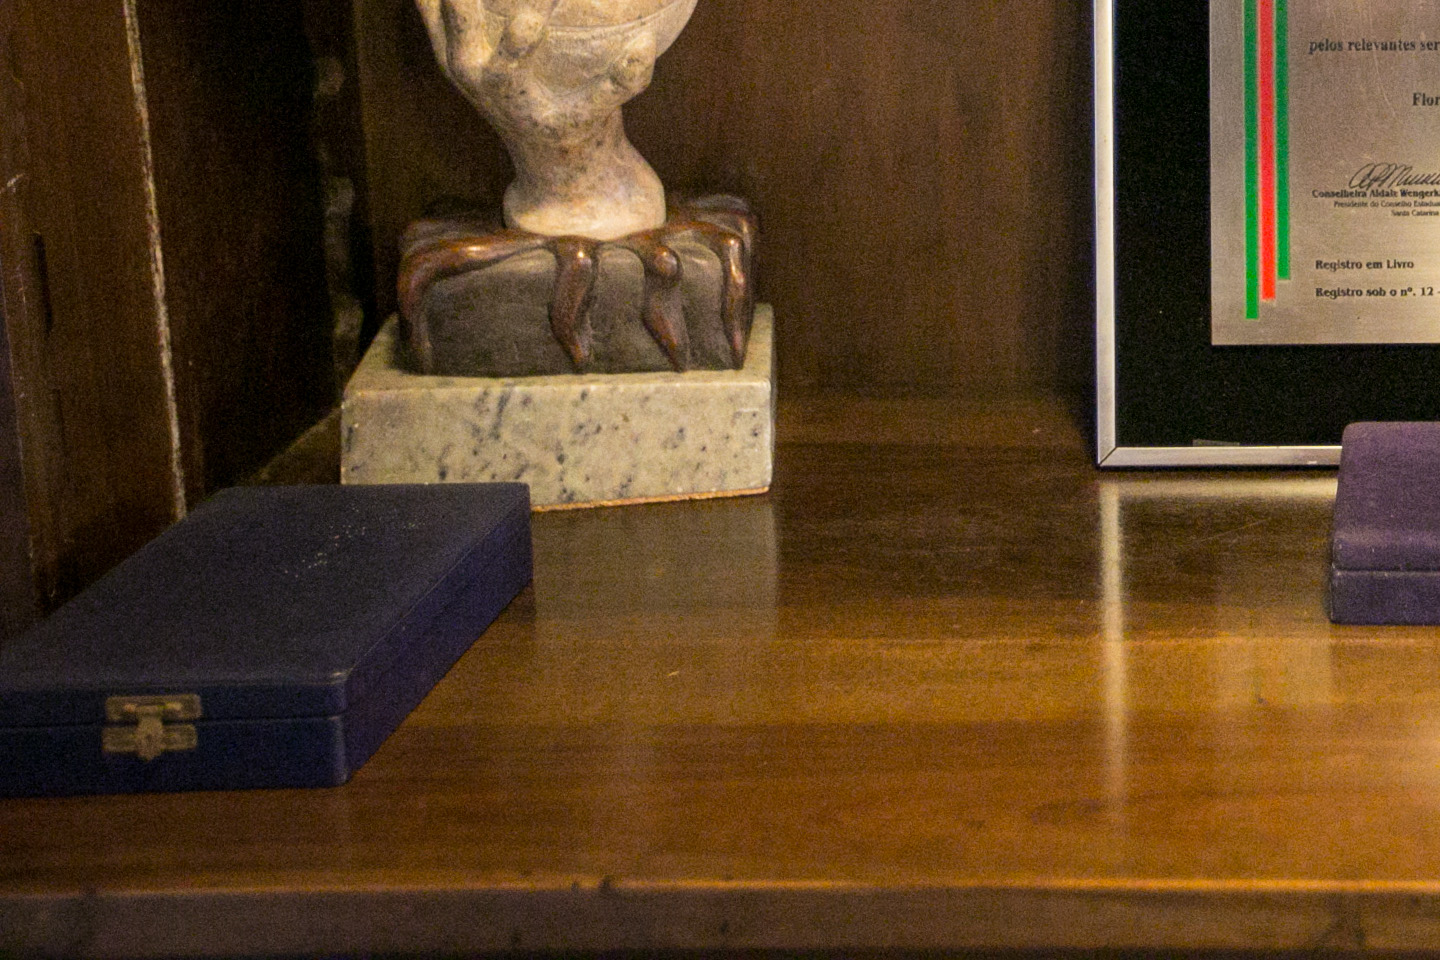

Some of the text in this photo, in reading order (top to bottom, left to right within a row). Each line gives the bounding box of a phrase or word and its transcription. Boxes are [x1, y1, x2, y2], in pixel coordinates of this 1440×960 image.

[1309, 38, 1344, 54] pelos
[1348, 38, 1415, 51] relevantes
[1315, 259, 1414, 272] Registro em Livro
[1315, 287, 1363, 300] Registro
[1366, 287, 1386, 297] sob
[1389, 289, 1397, 297] o
[1420, 286, 1434, 296] 12
